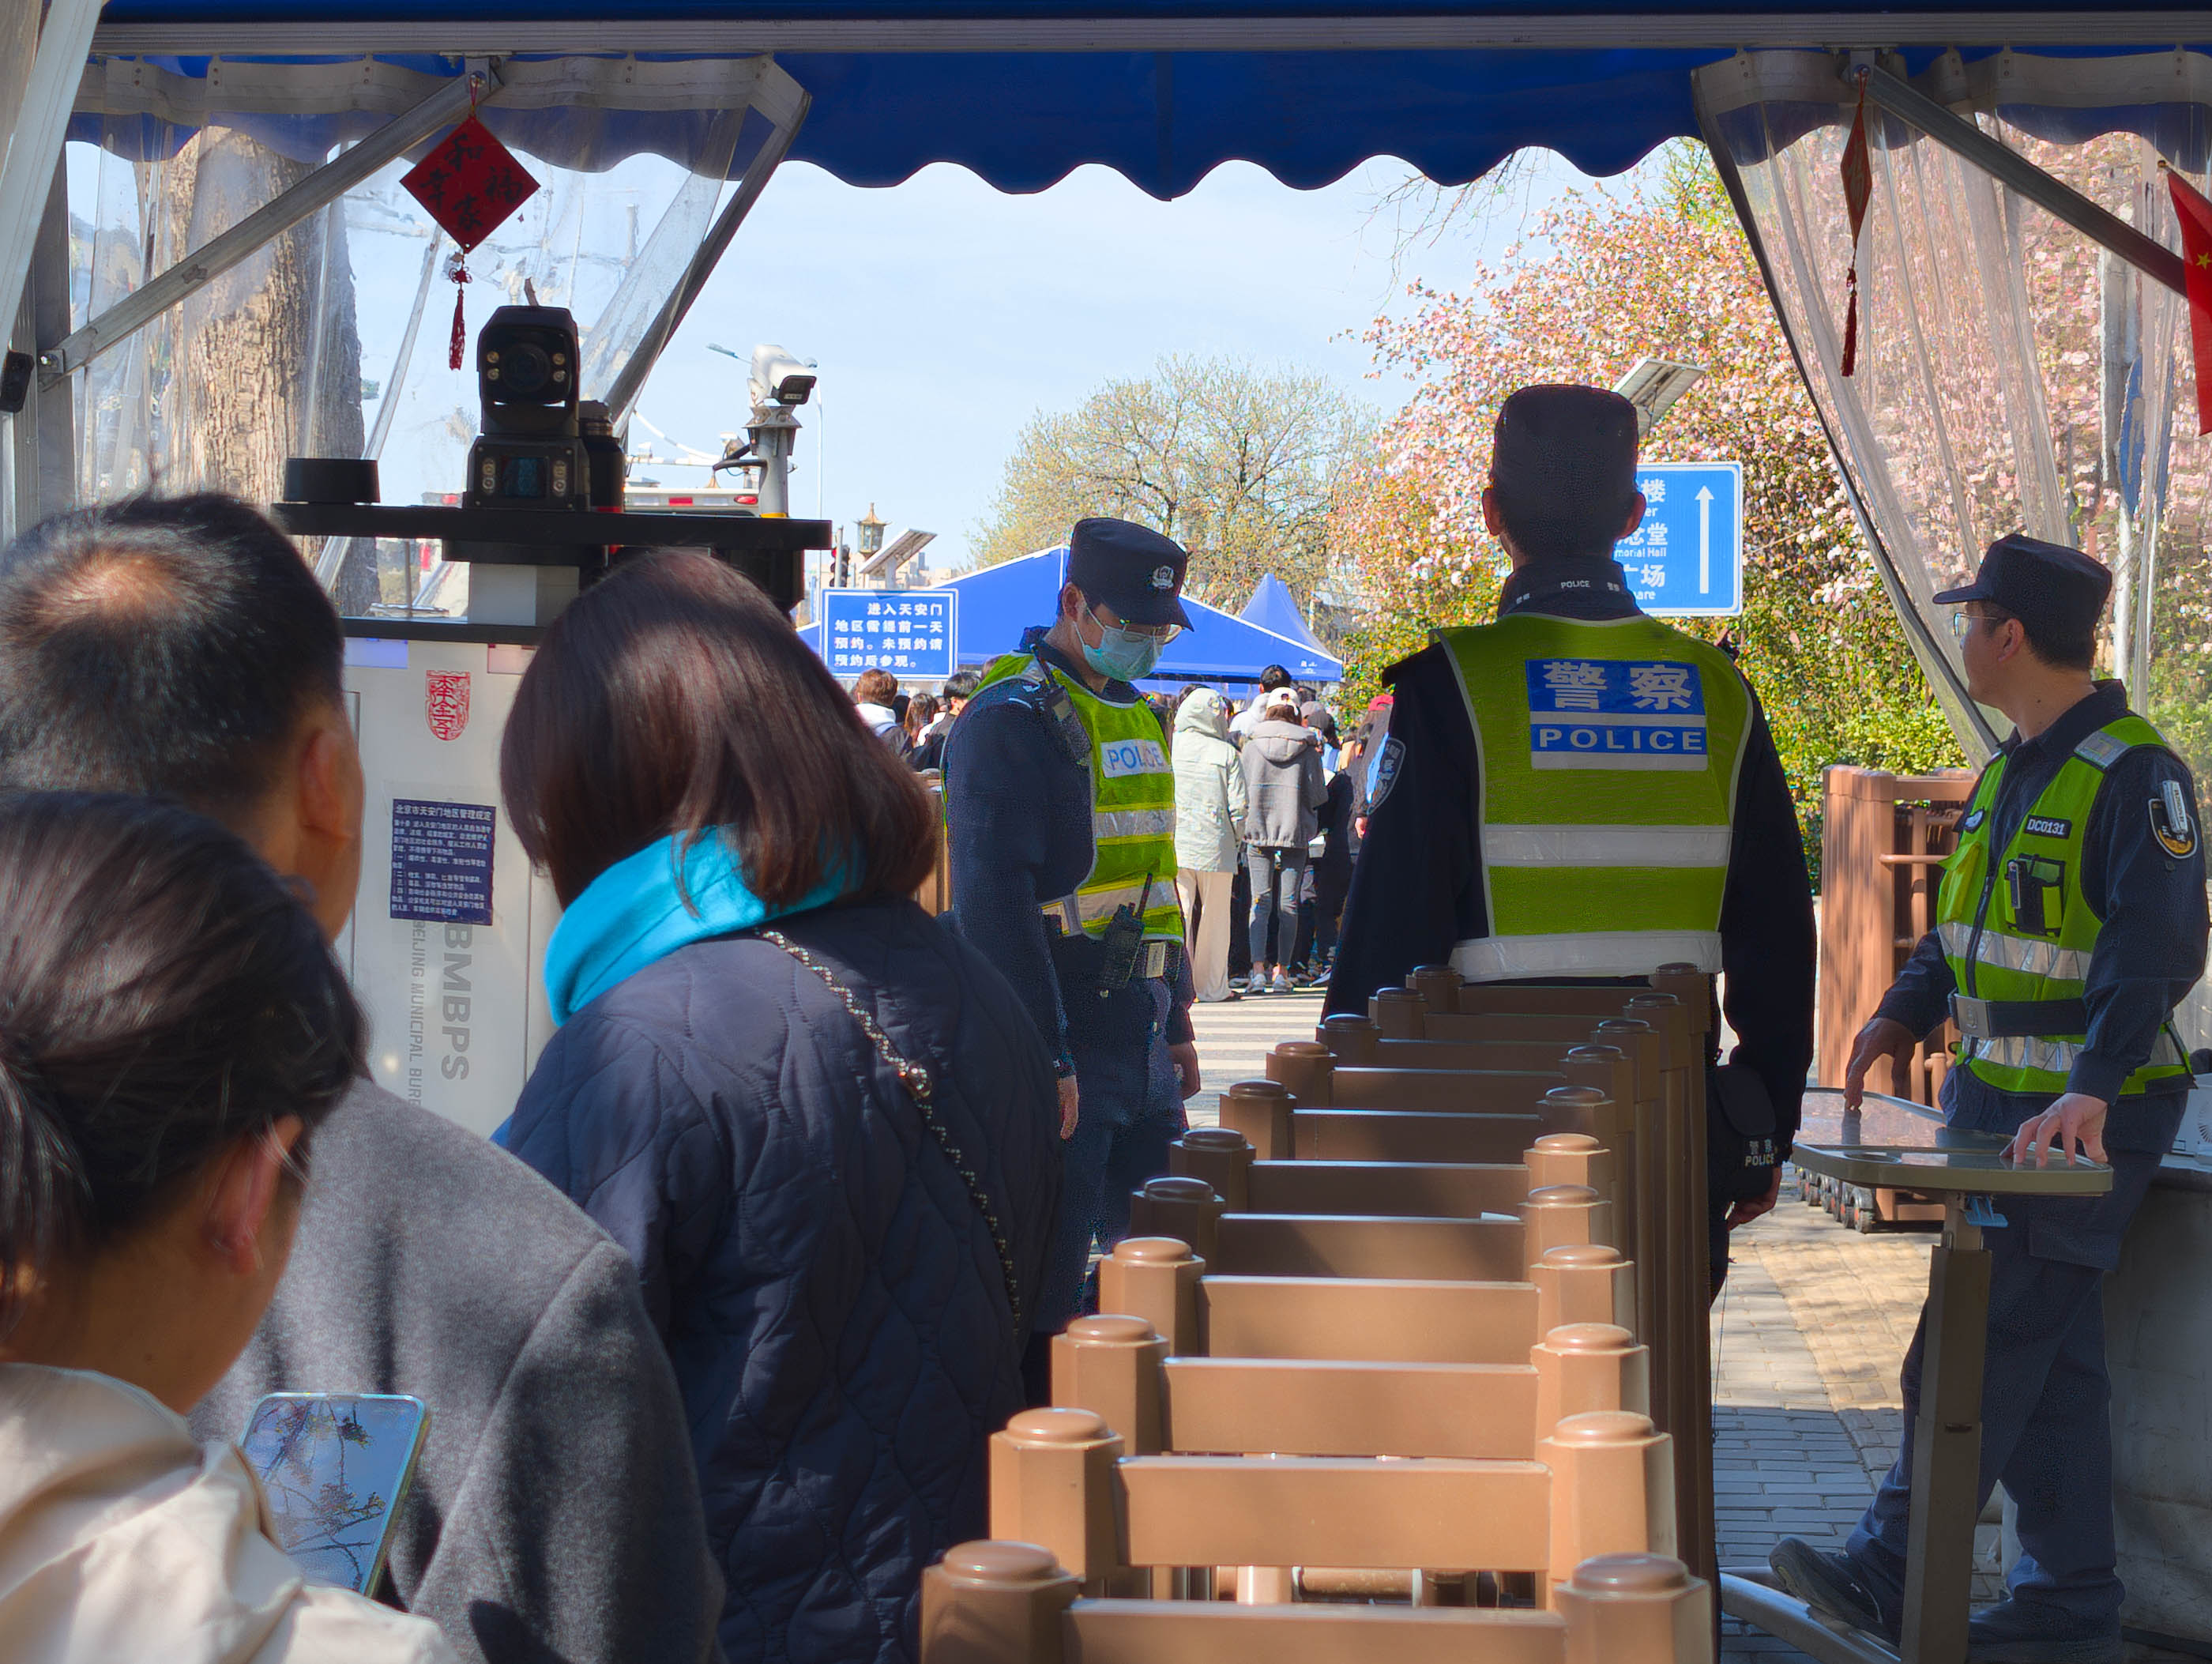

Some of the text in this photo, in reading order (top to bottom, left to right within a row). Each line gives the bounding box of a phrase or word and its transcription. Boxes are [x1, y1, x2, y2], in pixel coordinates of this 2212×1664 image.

[1648, 547, 1667, 557] Hall
[1560, 580, 1591, 589] POLICE
[867, 602, 942, 616] 进入天安门
[834, 619, 943, 633] 地区需提前一天
[1543, 661, 1693, 710] 警察
[1540, 728, 1702, 751] POLICE
[441, 923, 473, 1081] BMBPS
[408, 983, 425, 1063] MUNICIPAL
[1744, 1153, 1775, 1167] POLICE
